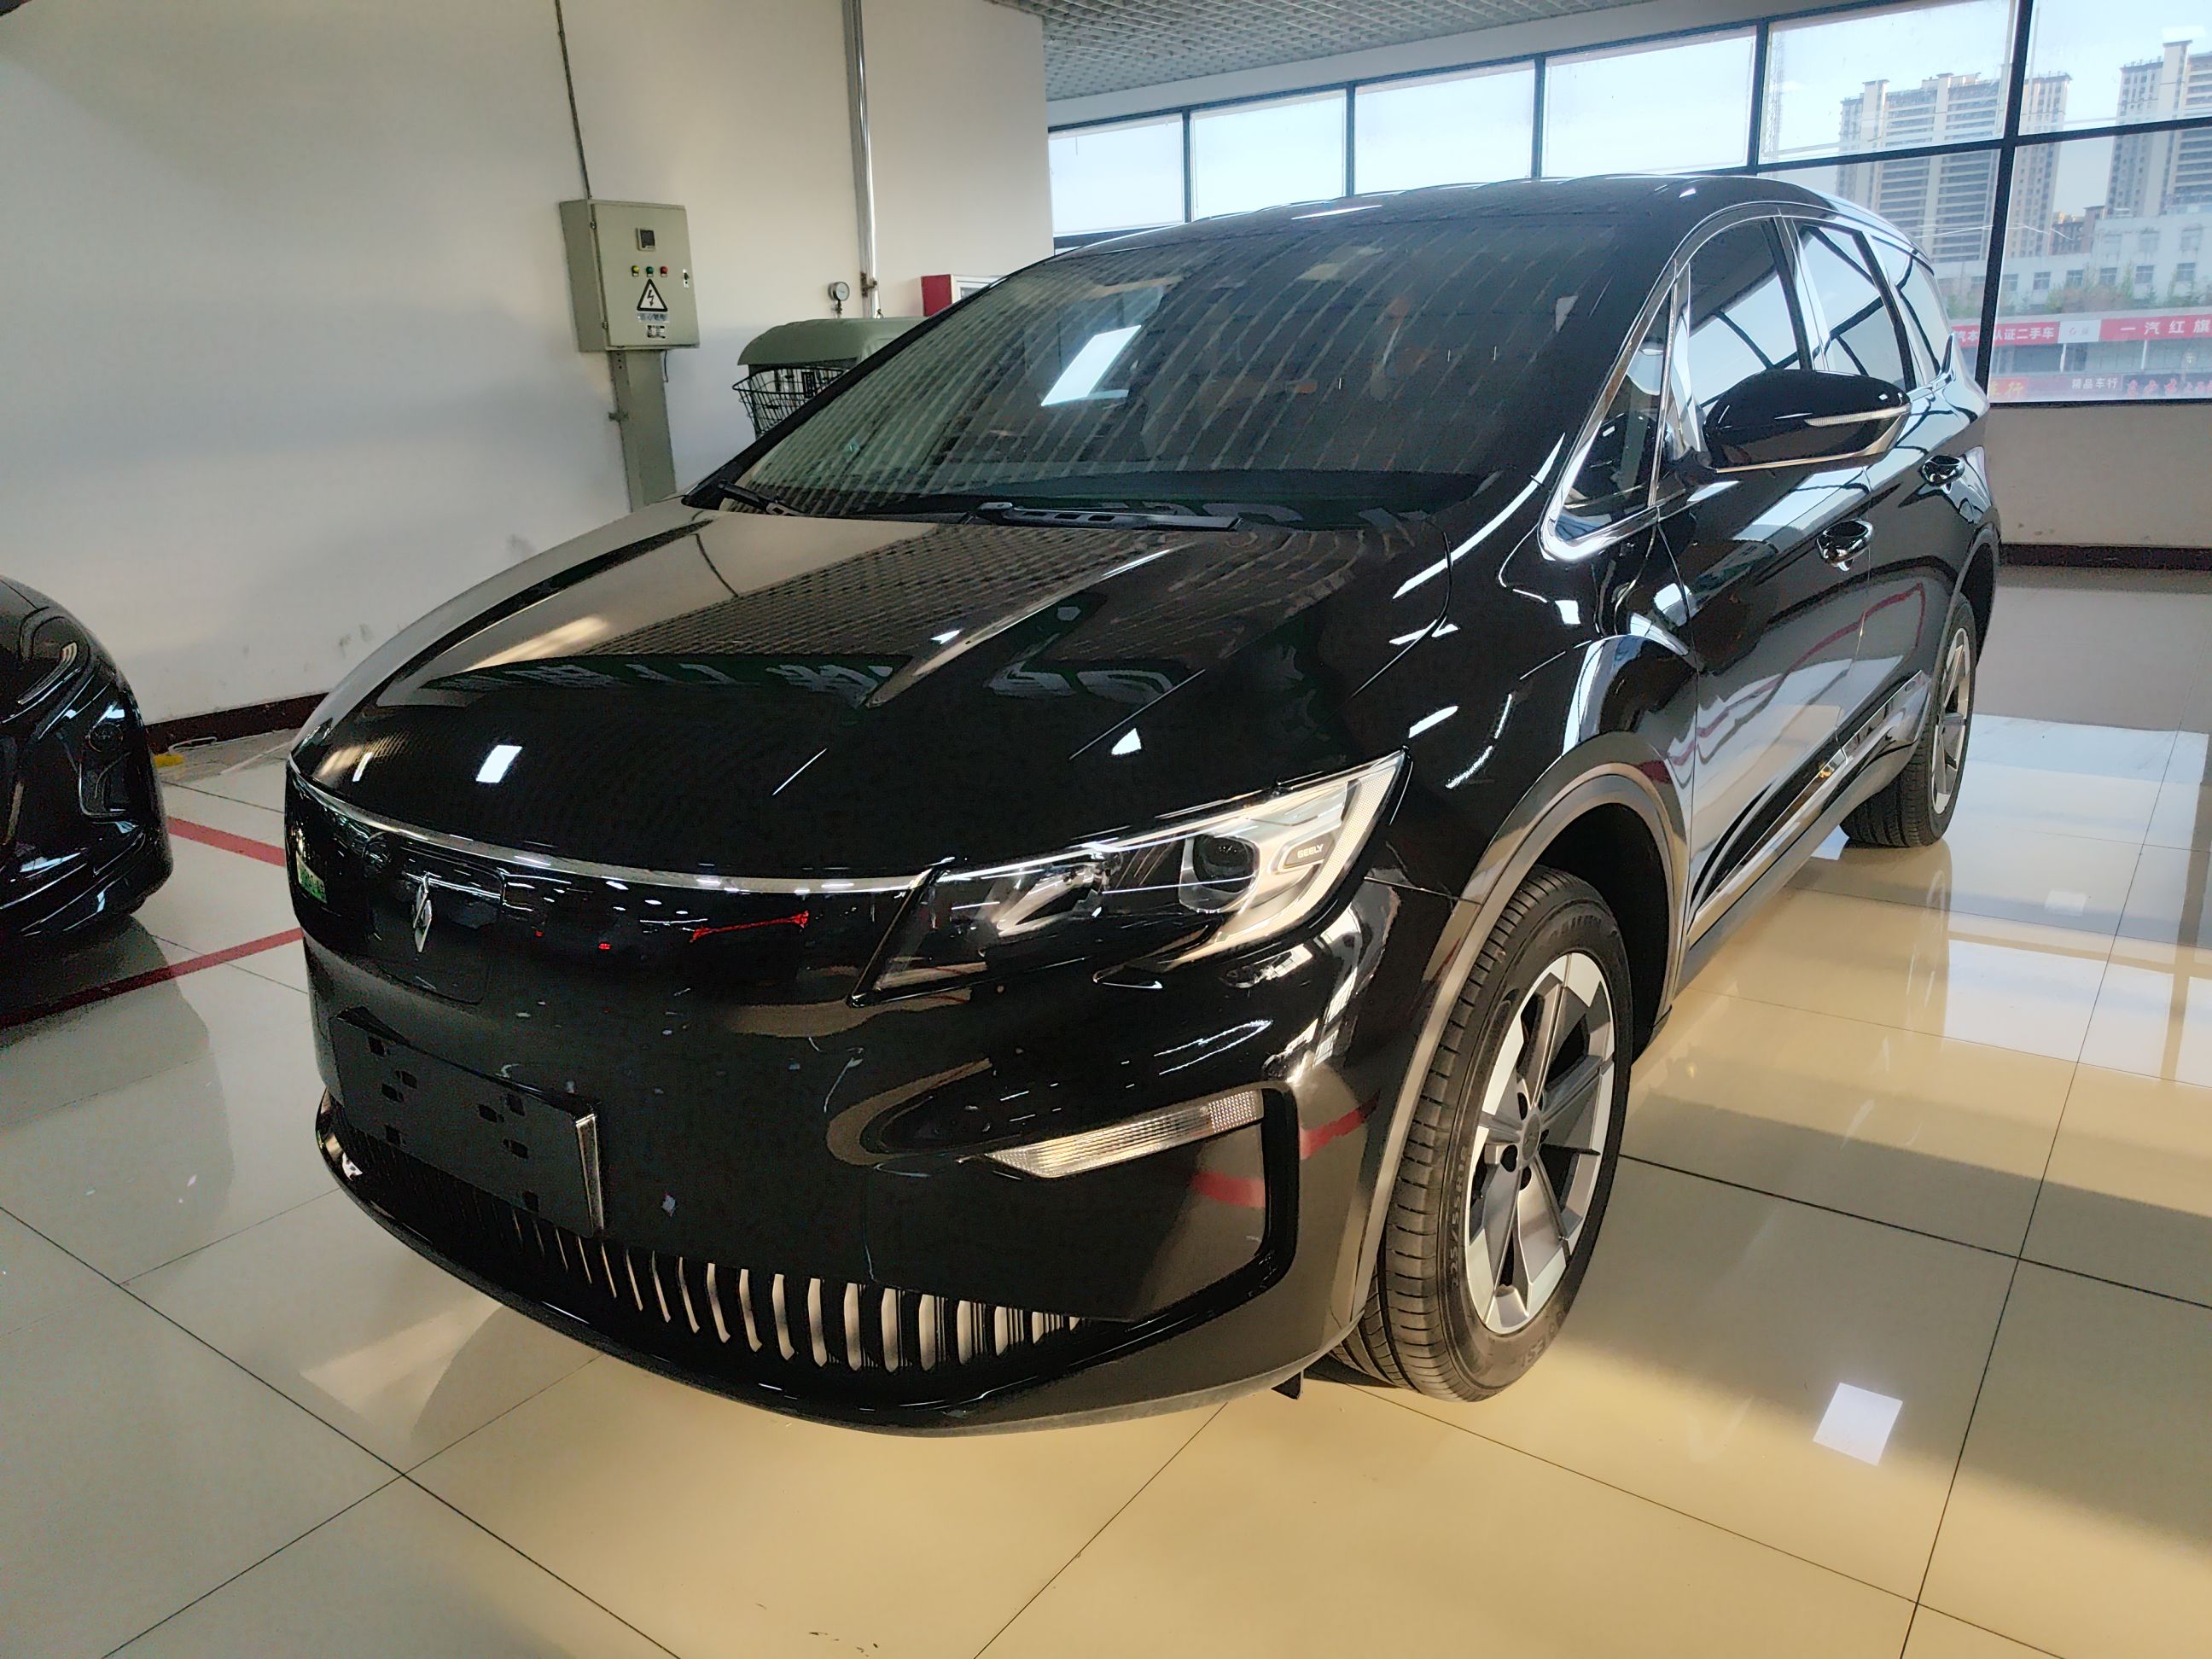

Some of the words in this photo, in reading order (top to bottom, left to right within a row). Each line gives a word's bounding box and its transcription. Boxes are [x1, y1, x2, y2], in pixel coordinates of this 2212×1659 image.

[2121, 319, 2211, 335] 一汽红旗
[2072, 378, 2117, 390] 精品车行
[1297, 843, 1324, 859] GEELY
